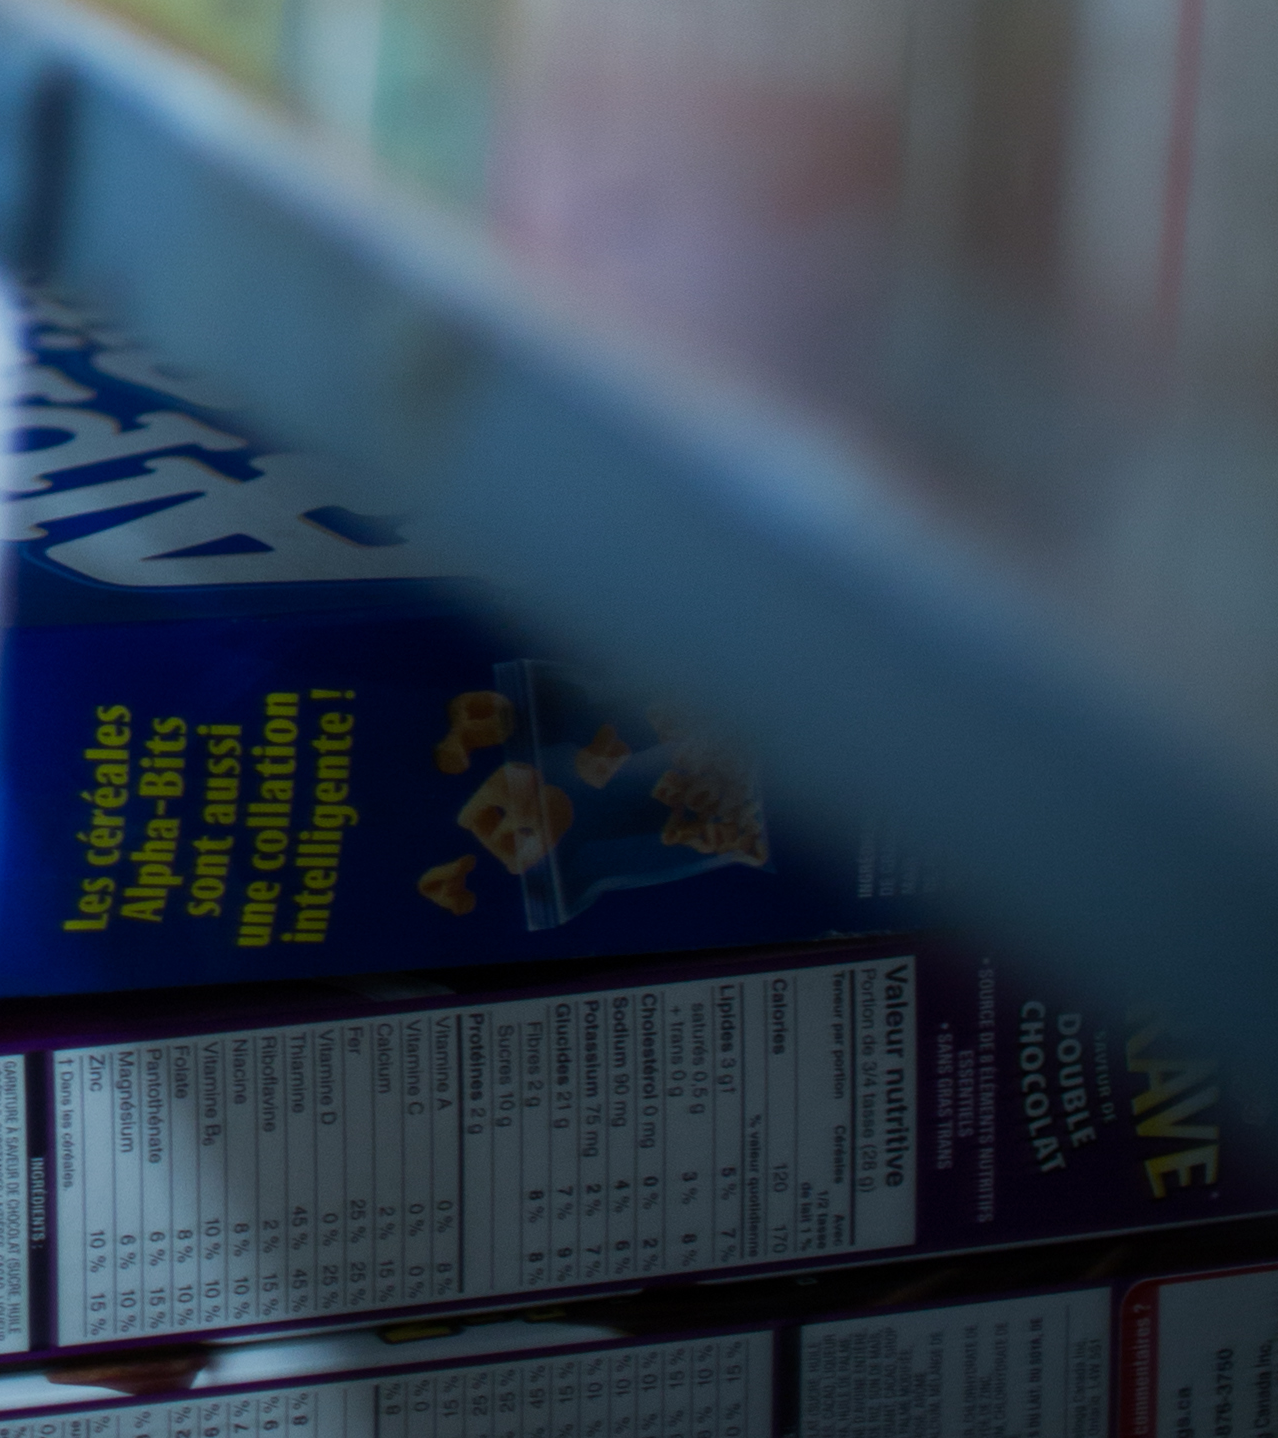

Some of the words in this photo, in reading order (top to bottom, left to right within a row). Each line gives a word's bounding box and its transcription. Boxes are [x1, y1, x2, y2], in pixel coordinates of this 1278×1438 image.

[76, 704, 131, 867] céréales
[196, 724, 242, 825] aussi
[245, 692, 299, 870] collation
[120, 717, 187, 922] Alpha-Bits
[280, 712, 359, 942] intelligente
[63, 876, 116, 930] Les
[186, 836, 234, 917] sont
[237, 881, 282, 947] une
[612, 995, 628, 1068] Sodium
[720, 983, 736, 1054] Lipides
[771, 977, 788, 1056] Calories
[860, 968, 877, 1030] Portion
[885, 964, 909, 1058] Valeur
[89, 1054, 106, 1093] Zinc
[174, 1044, 190, 1100] Folate
[232, 1038, 248, 1106] Niacine
[290, 1032, 306, 1115] Thiamine
[317, 1028, 336, 1107] Vitamine
[347, 1026, 363, 1056] Fer
[376, 1023, 393, 1095] Calcium
[404, 1019, 424, 1098] Vitamine
[433, 1017, 451, 1095] Vitamine
[468, 1012, 485, 1102] Protéines
[497, 1024, 514, 1086] Sucres
[527, 1021, 542, 1076] Fibres
[555, 1002, 572, 1086] Glucides
[583, 999, 599, 1098] Potassium
[861, 1037, 877, 1058] de
[936, 1033, 953, 1075] SANS
[58, 1071, 74, 1100] Dans
[115, 1050, 135, 1154] Magnésium
[146, 1047, 164, 1165] Pantothénate
[200, 1041, 219, 1119] Vitamine
[261, 1037, 278, 1134] Riboflavine
[408, 1101, 424, 1116] C
[861, 1092, 877, 1140] tasse
[937, 1077, 953, 1118] GRAS
[957, 1049, 974, 1137] ESSENTIELS
[1019, 1000, 1067, 1174] CHOCOLAT
[1056, 1013, 1097, 1148] DOUBLE
[62, 1109, 73, 1128] les
[321, 1111, 337, 1127] D
[884, 1067, 908, 1189] nutritive
[936, 1120, 953, 1170] TRANS
[89, 1229, 106, 1249] 10
[89, 1255, 107, 1274] %
